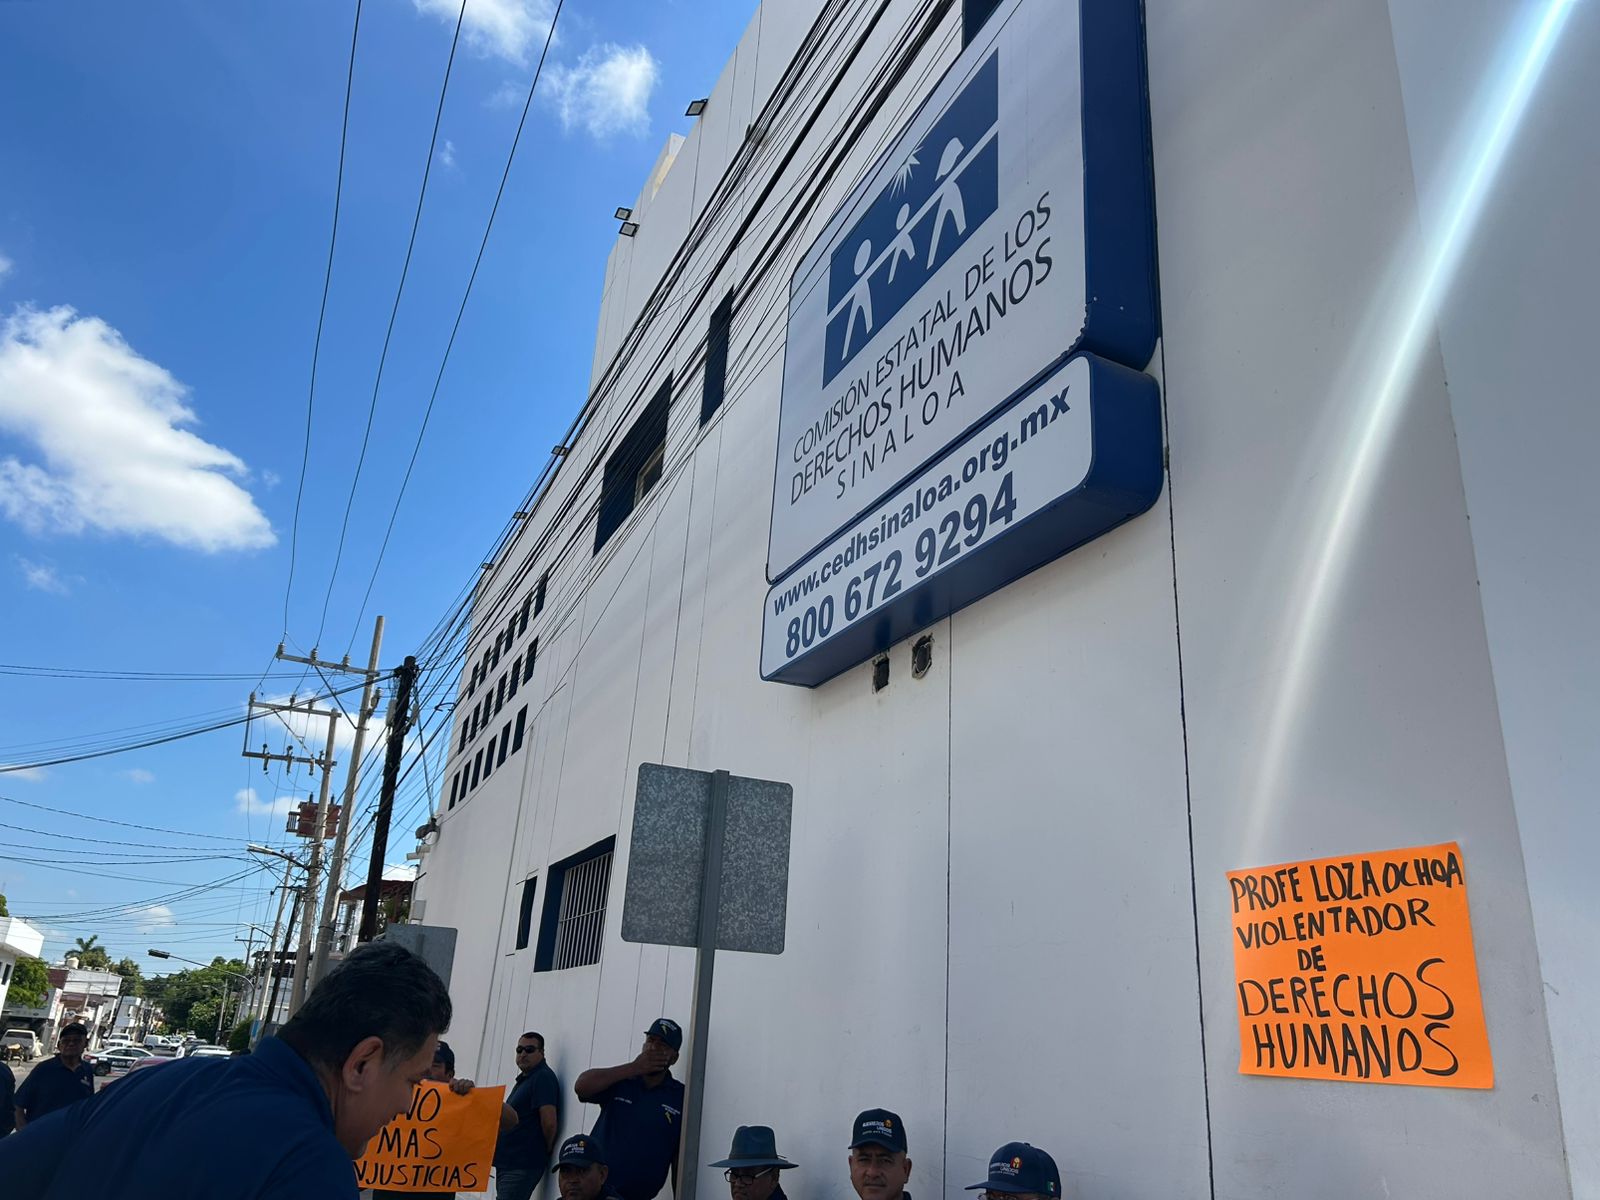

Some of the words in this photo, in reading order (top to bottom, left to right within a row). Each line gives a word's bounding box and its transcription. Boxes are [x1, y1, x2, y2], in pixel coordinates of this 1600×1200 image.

[793, 370, 870, 463] COMISIÓN
[875, 290, 957, 384] ESTATAL
[964, 246, 995, 302] DE
[1004, 191, 1051, 258] LOS
[791, 387, 892, 505] DERECHOS
[900, 237, 1053, 409] HUMANOS
[837, 371, 965, 499] SINALOA
[773, 385, 1071, 616] www.cedhsinaloa.org.mx
[785, 595, 834, 658] 800
[844, 550, 902, 621] 672
[915, 471, 1017, 578] 9294
[1230, 866, 1303, 913] PROFE
[1236, 898, 1436, 949] VIOLENTADOR
[1297, 945, 1327, 972] DE
[1238, 958, 1454, 1021] DERECHOS
[1253, 1022, 1459, 1078] HUMANOS
[377, 1126, 443, 1160] MAS
[353, 1160, 478, 1189] NJUSTICIAS
